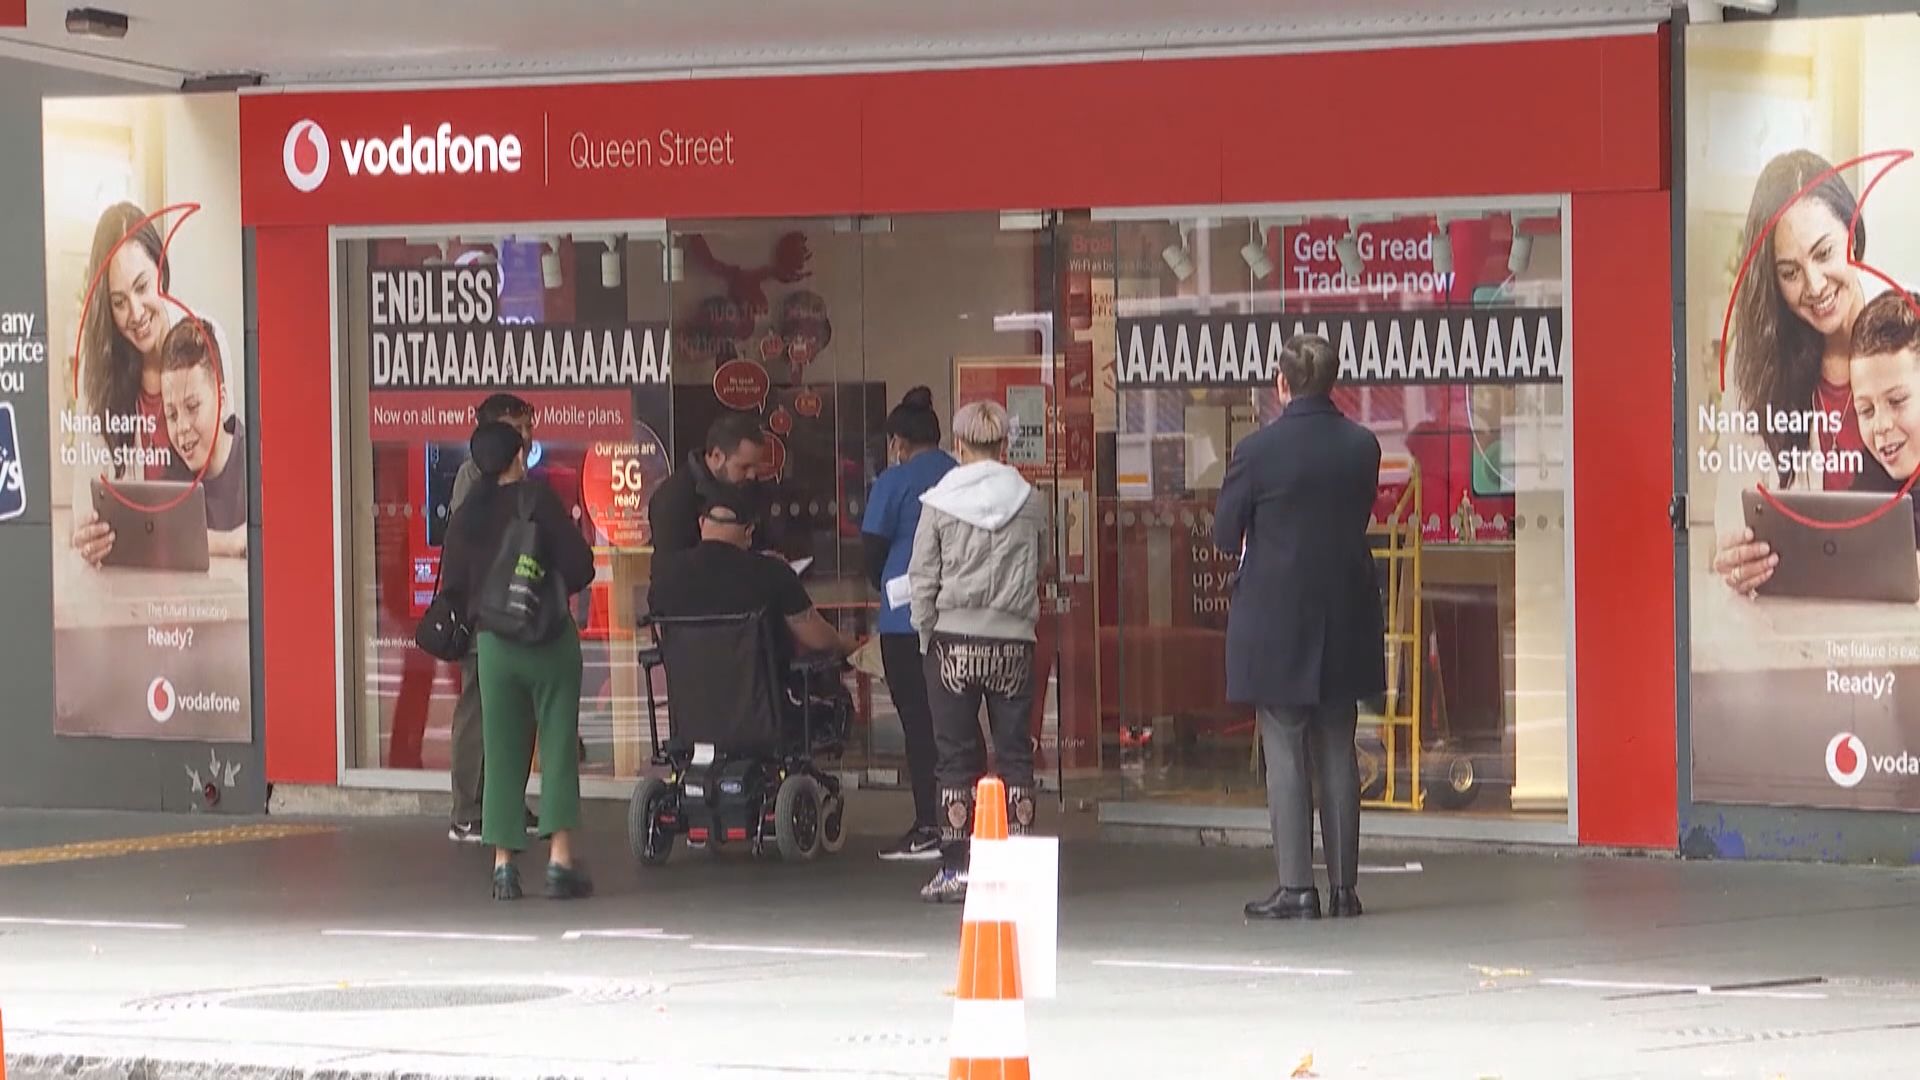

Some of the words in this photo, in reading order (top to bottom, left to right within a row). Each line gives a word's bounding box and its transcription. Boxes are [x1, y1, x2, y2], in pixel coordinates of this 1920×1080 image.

[340, 122, 522, 175] vodafone
[570, 131, 651, 169] Queen
[659, 129, 735, 166] Street
[1294, 232, 1336, 261] Get
[1380, 232, 1433, 261] read
[1294, 265, 1360, 294] Trade
[1367, 271, 1397, 300] up
[1403, 271, 1455, 294] now
[371, 269, 493, 325] ENDLESS
[2, 312, 35, 338] any
[0, 337, 44, 368] price
[0, 371, 24, 393] ou
[61, 408, 101, 434] Nana
[105, 408, 157, 434] learns
[374, 405, 400, 425] Now
[403, 409, 419, 425] on
[421, 405, 436, 425] all
[438, 408, 465, 425] new
[544, 405, 585, 426] Mobile
[588, 405, 624, 429] plans.
[1698, 404, 1759, 433] Nana
[1766, 404, 1842, 434] learns
[61, 443, 77, 465] to
[81, 441, 109, 465] live
[113, 443, 171, 466] stream
[595, 442, 612, 457] Our
[614, 443, 640, 459] plans
[641, 443, 656, 456] are
[1698, 444, 1722, 472] to
[1728, 443, 1771, 472] live
[1778, 446, 1863, 473] stream
[611, 458, 642, 492] 5G
[614, 490, 640, 511] ready
[1192, 544, 1209, 562] to
[1193, 572, 1213, 592] up
[147, 603, 162, 618] The
[1193, 593, 1231, 614] hom
[147, 626, 194, 651] Ready?
[1826, 640, 1848, 658] The
[1850, 640, 1886, 659] future
[1889, 642, 1898, 658] is
[1826, 669, 1896, 700] Ready?
[177, 690, 240, 713] vodafone
[1872, 751, 1920, 775] voda
